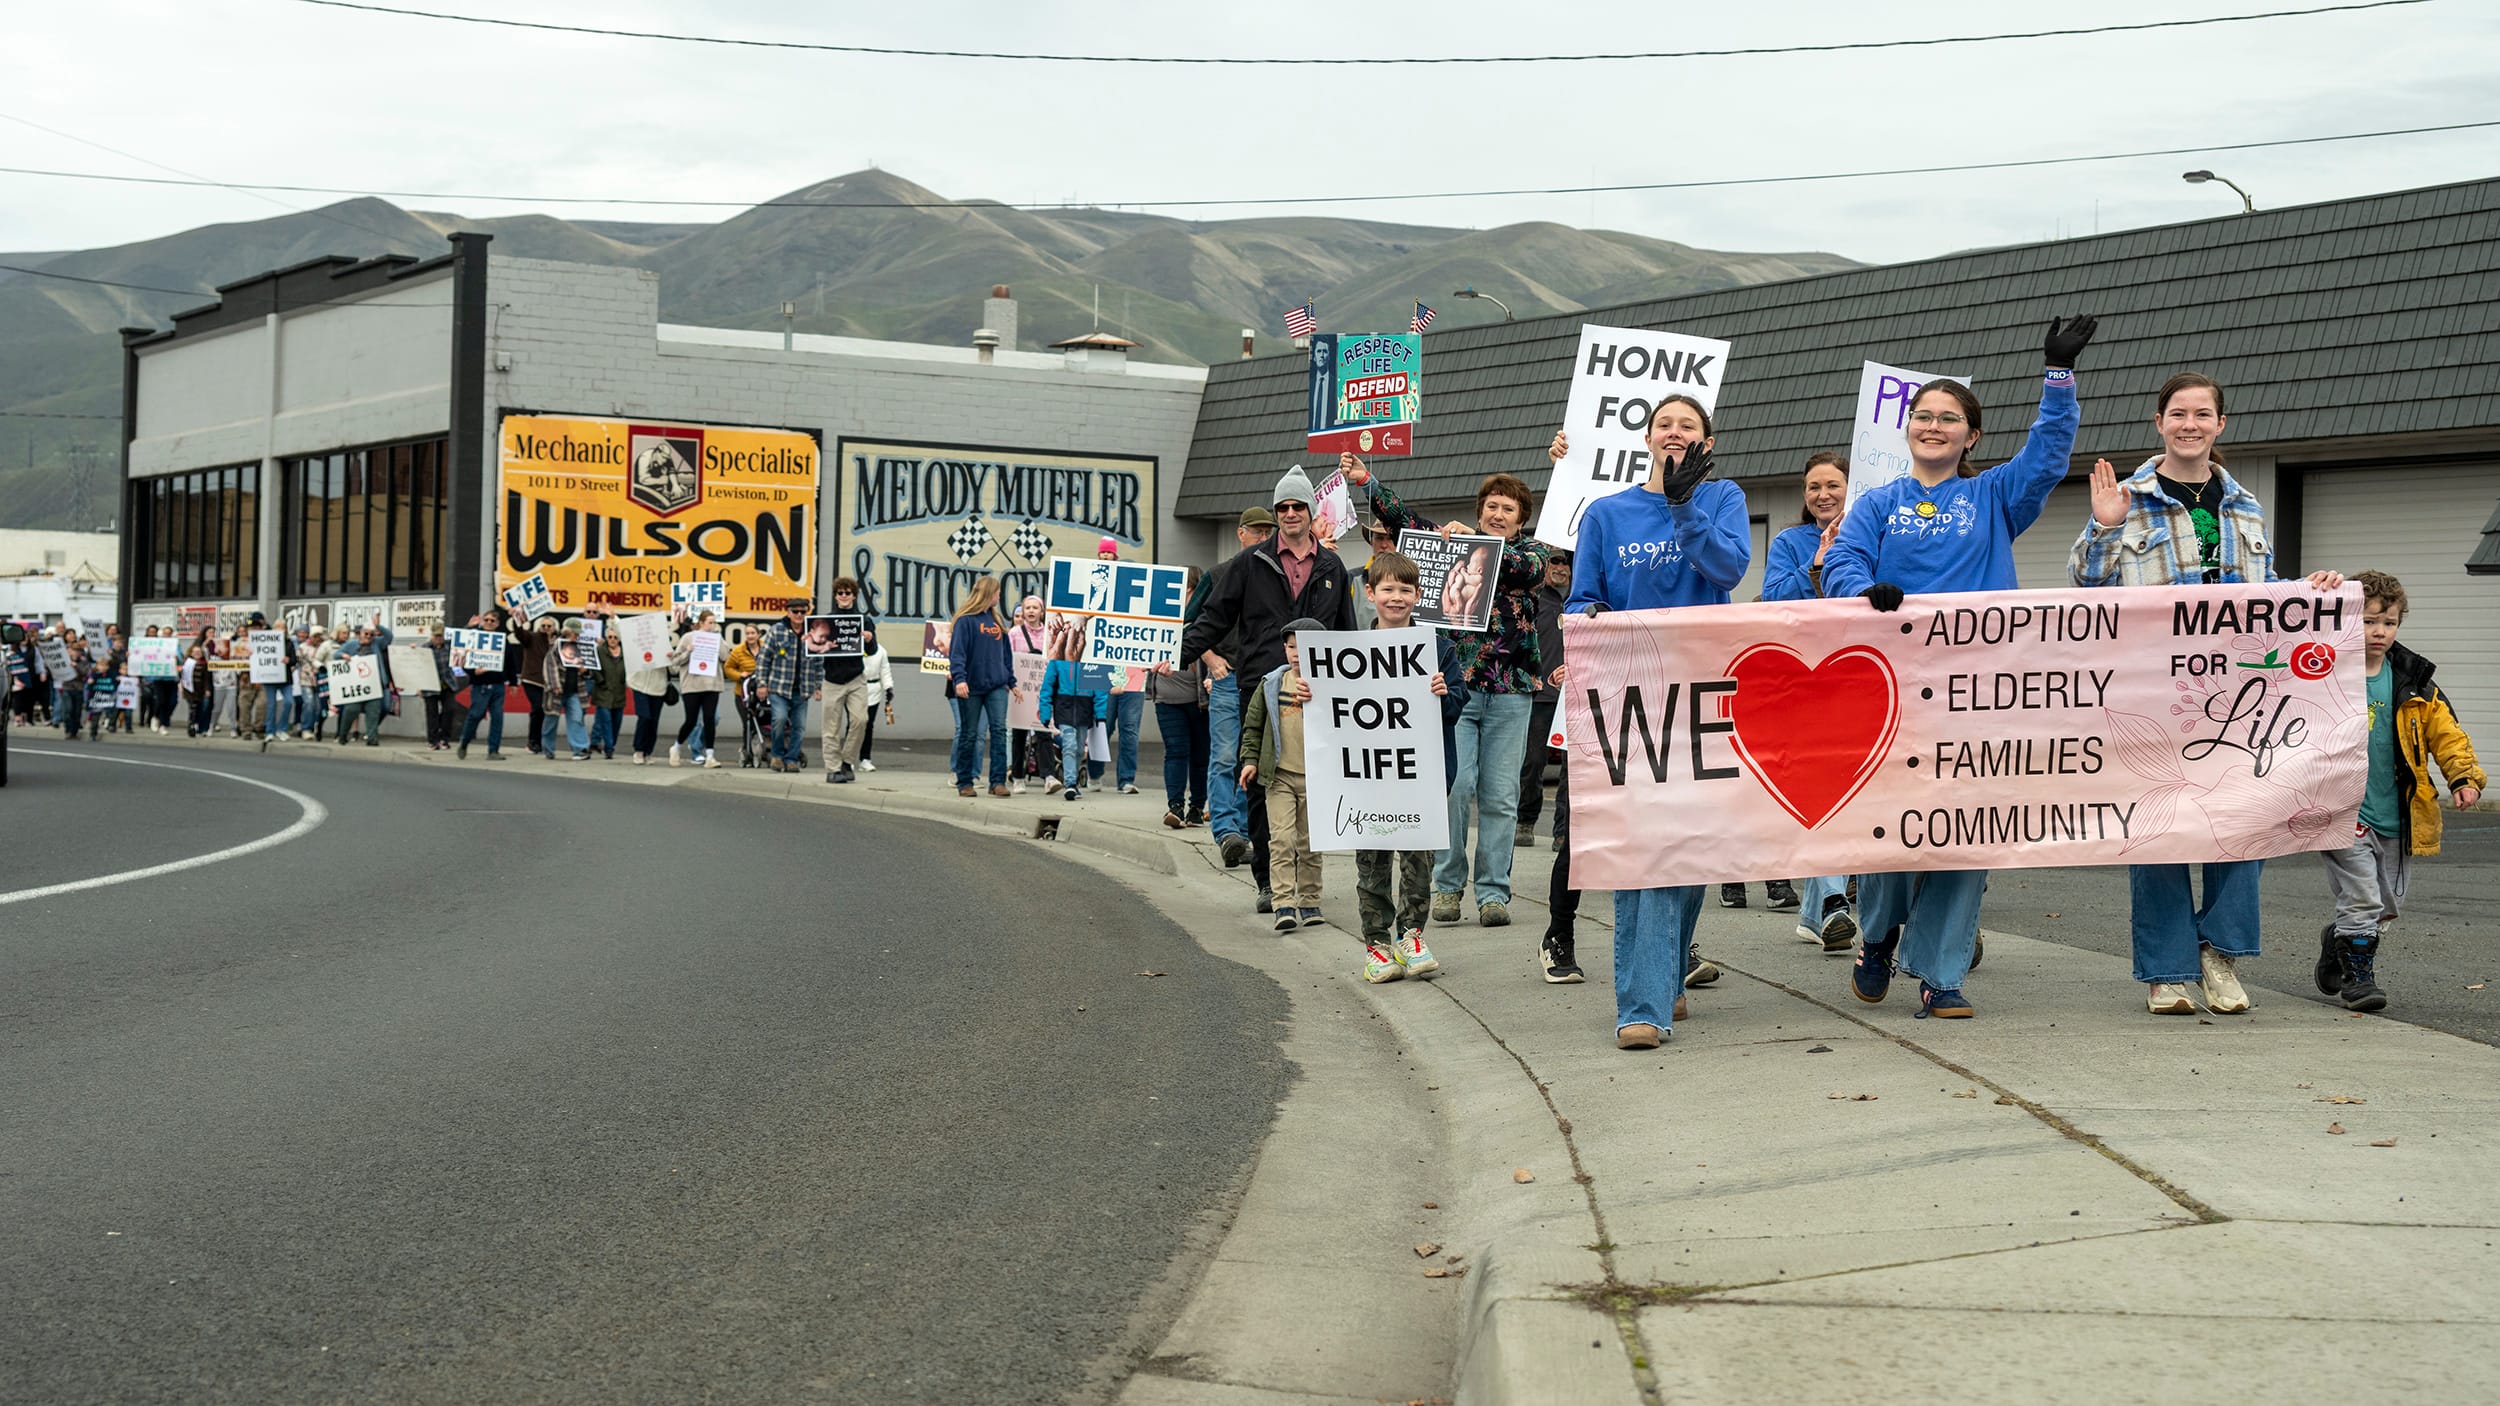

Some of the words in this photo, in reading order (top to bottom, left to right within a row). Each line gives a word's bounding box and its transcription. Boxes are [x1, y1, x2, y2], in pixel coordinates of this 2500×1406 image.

[1344, 338, 1412, 364] RESPECT
[1363, 358, 1392, 372] LIFE
[1586, 343, 1716, 387] HONK
[1348, 376, 1406, 398] DEFEND
[1362, 402, 1390, 416] LIFE
[1596, 396, 1653, 431] FO
[514, 434, 624, 466] Mechanic
[705, 446, 811, 476] Specialist
[1858, 431, 1910, 474] Caring
[1592, 448, 1654, 482] LIF
[528, 476, 560, 488] 1011
[565, 478, 576, 489] D
[580, 478, 620, 492] Street
[708, 486, 769, 501] Lewiston,
[773, 490, 788, 502] ID
[1324, 475, 1343, 496] LIFE!
[852, 456, 990, 532] MELODY
[992, 464, 1143, 542] MUFFLER
[507, 488, 806, 585] WILSON
[1891, 526, 1915, 535] in
[1404, 550, 1458, 564] SMALLEST
[1406, 538, 1441, 552] EVEN
[1446, 542, 1469, 554] THE
[1618, 540, 1681, 558] ROOTE
[1434, 562, 1450, 570] CAN
[1622, 556, 1646, 568] in
[1650, 547, 1684, 570] love
[586, 564, 680, 585] AutoTech
[856, 548, 881, 618] &
[884, 555, 990, 618] HITC
[1430, 570, 1445, 578] THE
[505, 576, 546, 608] LIFE
[588, 591, 664, 607] DOMESTIC
[674, 584, 723, 602] LIFE
[1051, 560, 1183, 617] LIFE
[397, 601, 435, 612] IMPORTS
[2172, 596, 2343, 637] MARCH
[1095, 618, 1157, 643] RESPECT
[1925, 603, 2120, 647] ADOPTION
[251, 634, 281, 642] HONK
[257, 646, 276, 654] FOR
[454, 631, 503, 651] LIFE
[259, 658, 278, 667] LIFE
[1093, 639, 1153, 663] PROTECT
[1308, 643, 1428, 680] HONK
[141, 663, 171, 675] LIFE
[332, 663, 350, 676] PRO
[2171, 653, 2227, 677] FOR
[342, 685, 371, 698] Life
[1948, 669, 2115, 713] ELDERLY
[1332, 697, 1412, 730] FOR
[1587, 680, 1740, 786] WE
[2182, 676, 2308, 778] Life
[1342, 747, 1417, 780] LIFE
[1934, 735, 2104, 779] FAMILIES
[1900, 802, 2137, 849] COMMUNITY
